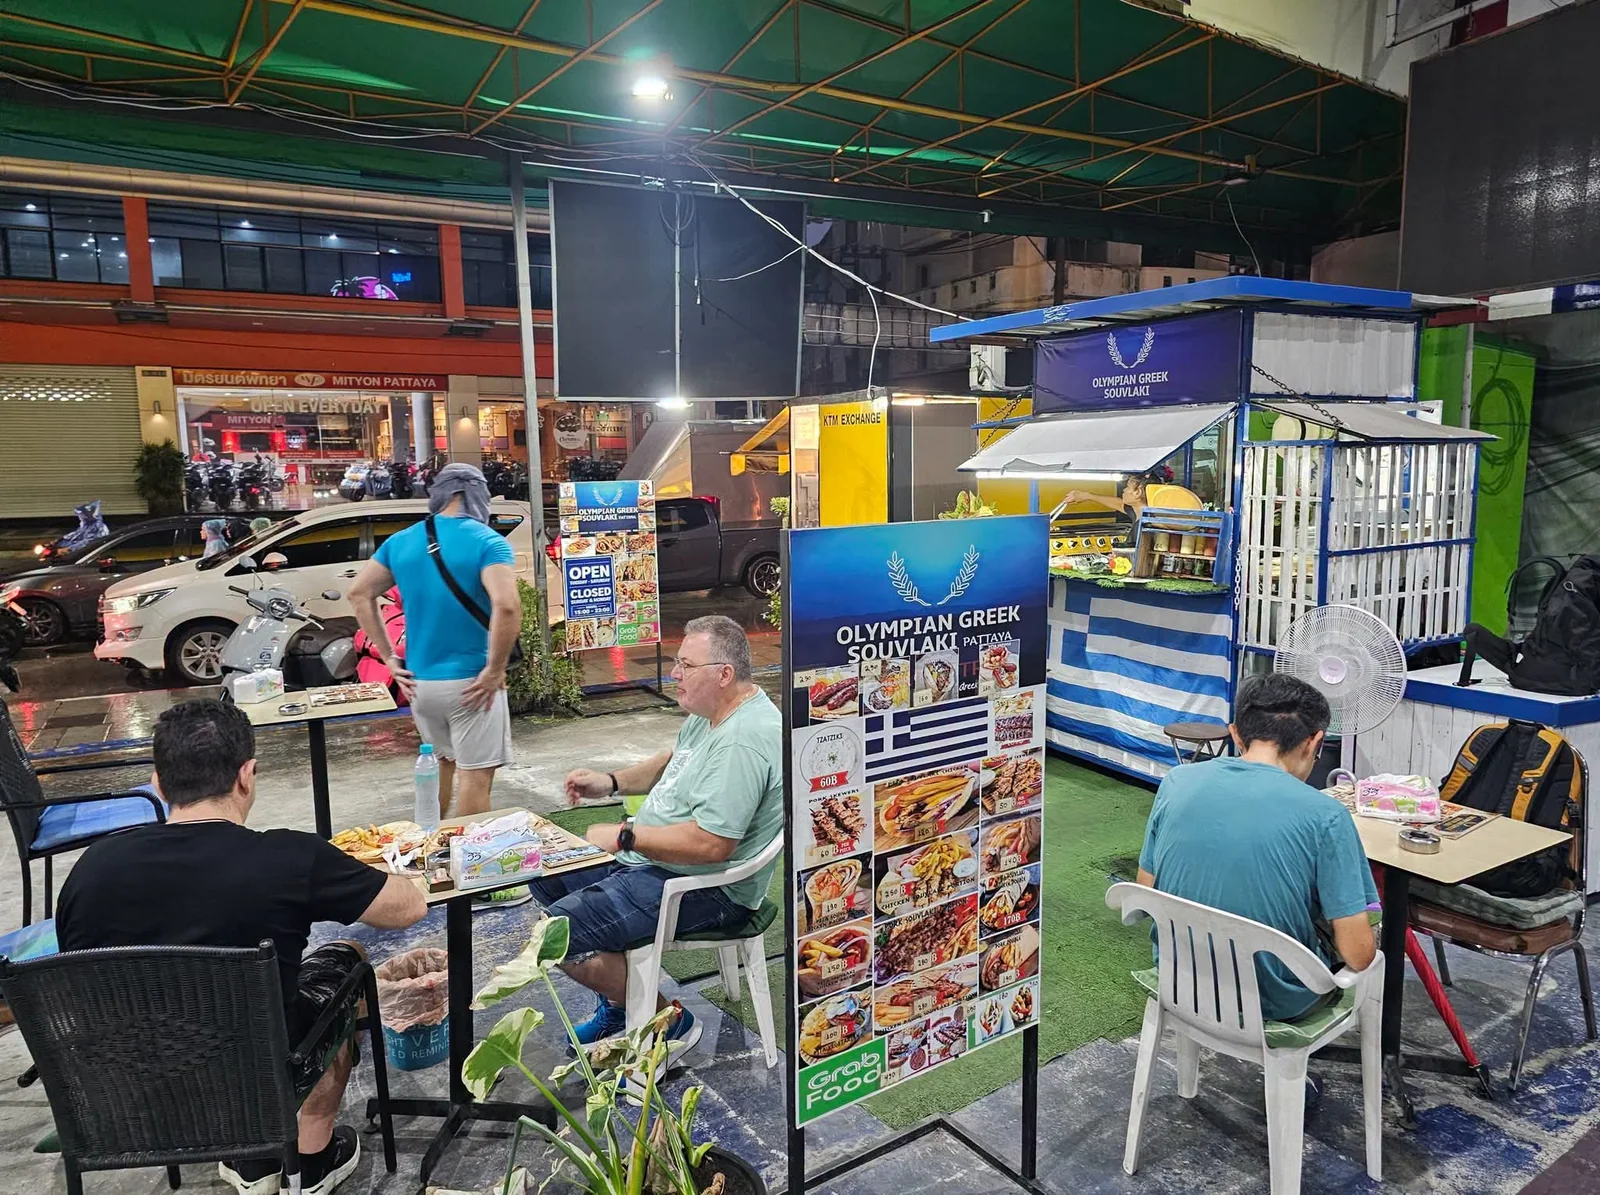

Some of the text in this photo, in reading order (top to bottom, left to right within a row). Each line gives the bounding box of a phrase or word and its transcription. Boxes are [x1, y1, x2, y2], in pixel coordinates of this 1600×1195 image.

[332, 375, 437, 388] MITYON PATTAYA
[1092, 371, 1169, 388] OLYMPIAN GREEK
[1103, 385, 1150, 399] SOUVLAKI
[250, 400, 296, 414] OPEN
[227, 415, 272, 425] MITYON
[823, 412, 882, 427] KTM EXCHANGE
[578, 506, 639, 516] OLYMPIAN GREEK
[582, 513, 618, 522] SOUVLAKI
[569, 564, 610, 580] OPEN
[570, 586, 612, 599] CLOSED
[619, 626, 637, 635] Grab
[836, 604, 1021, 645] OLYMPIAN GREEK
[847, 630, 1013, 664] SOUVLAKI PATTAYA
[816, 732, 844, 744] TZATZIKI
[820, 774, 838, 788] 60B
[1003, 912, 1021, 926] 170B
[808, 1052, 880, 1090] Grab
[806, 1062, 882, 1110] Food
